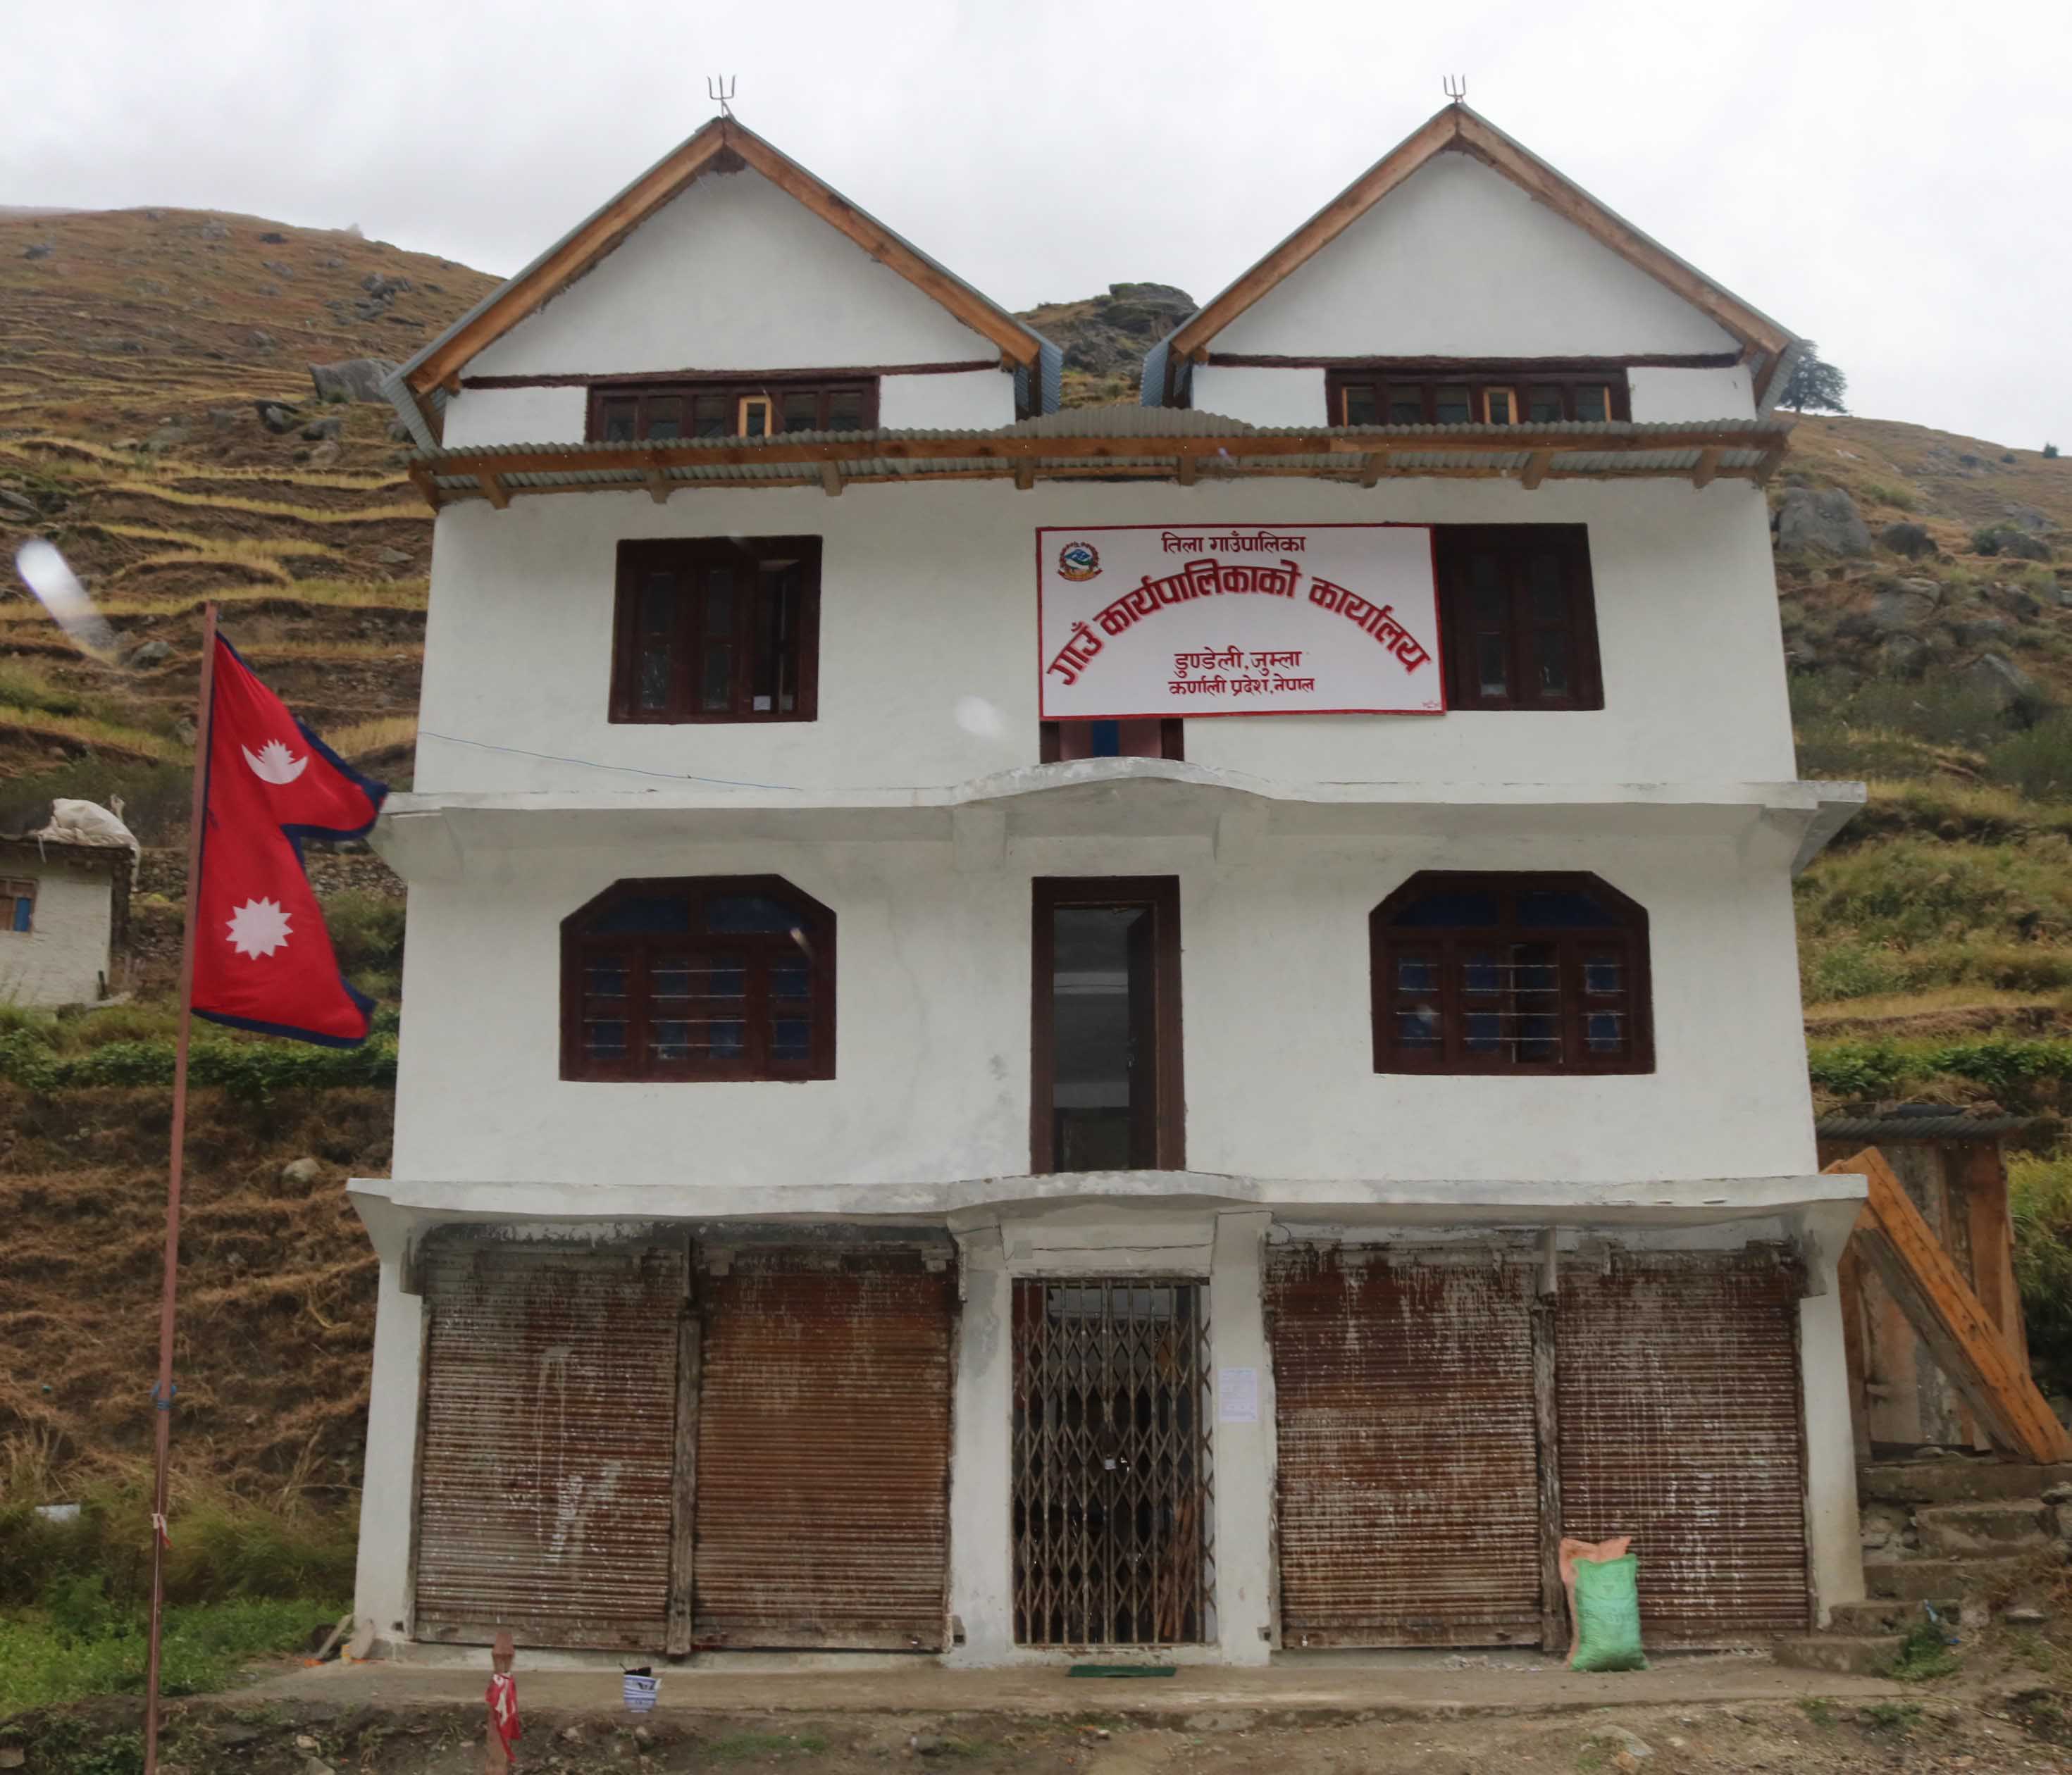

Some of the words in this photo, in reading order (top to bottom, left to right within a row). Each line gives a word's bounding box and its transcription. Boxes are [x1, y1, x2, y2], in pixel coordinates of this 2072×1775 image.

[1161, 531, 1205, 554] तिला
[1208, 530, 1307, 554] गाउँपालिका
[1046, 621, 1104, 686] गाउँ
[1093, 558, 1302, 636] कार्यपालिकाको
[1308, 576, 1432, 673] कार्यालय
[1167, 674, 1227, 696] कर्णाली
